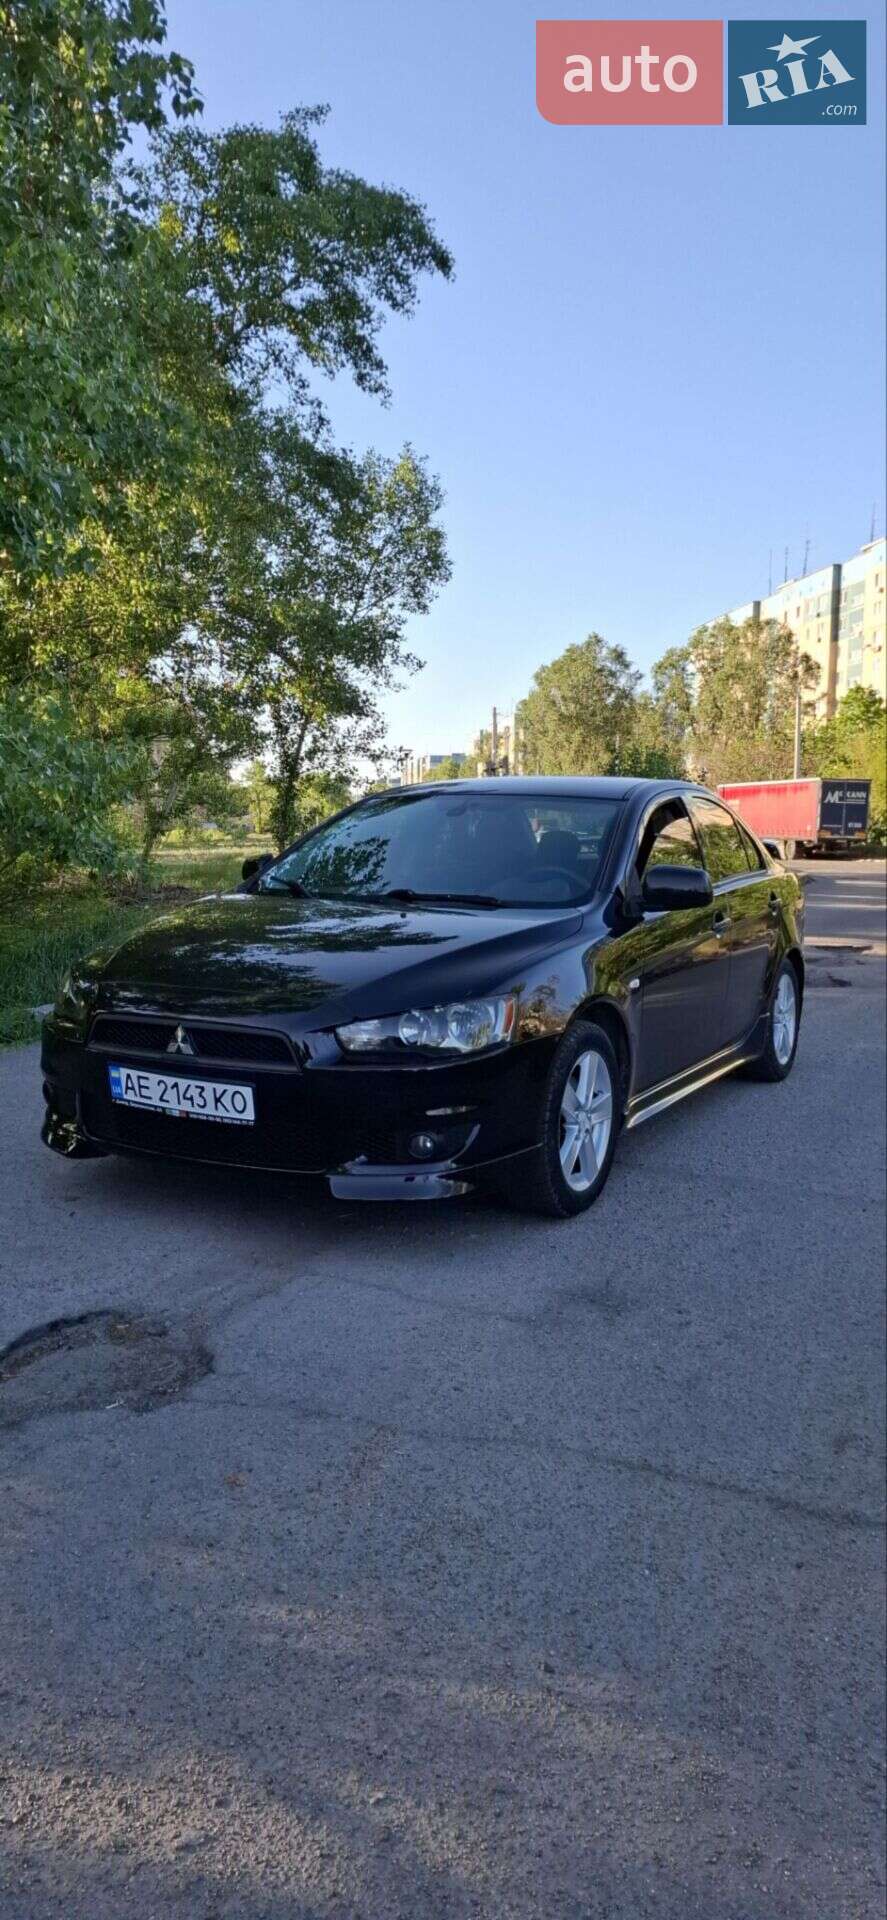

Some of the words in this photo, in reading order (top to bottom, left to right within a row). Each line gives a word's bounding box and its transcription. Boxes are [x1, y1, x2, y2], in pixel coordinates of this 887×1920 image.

[124, 1072, 153, 1100] AE
[157, 1079, 208, 1109] 2143
[213, 1087, 247, 1114] KO
